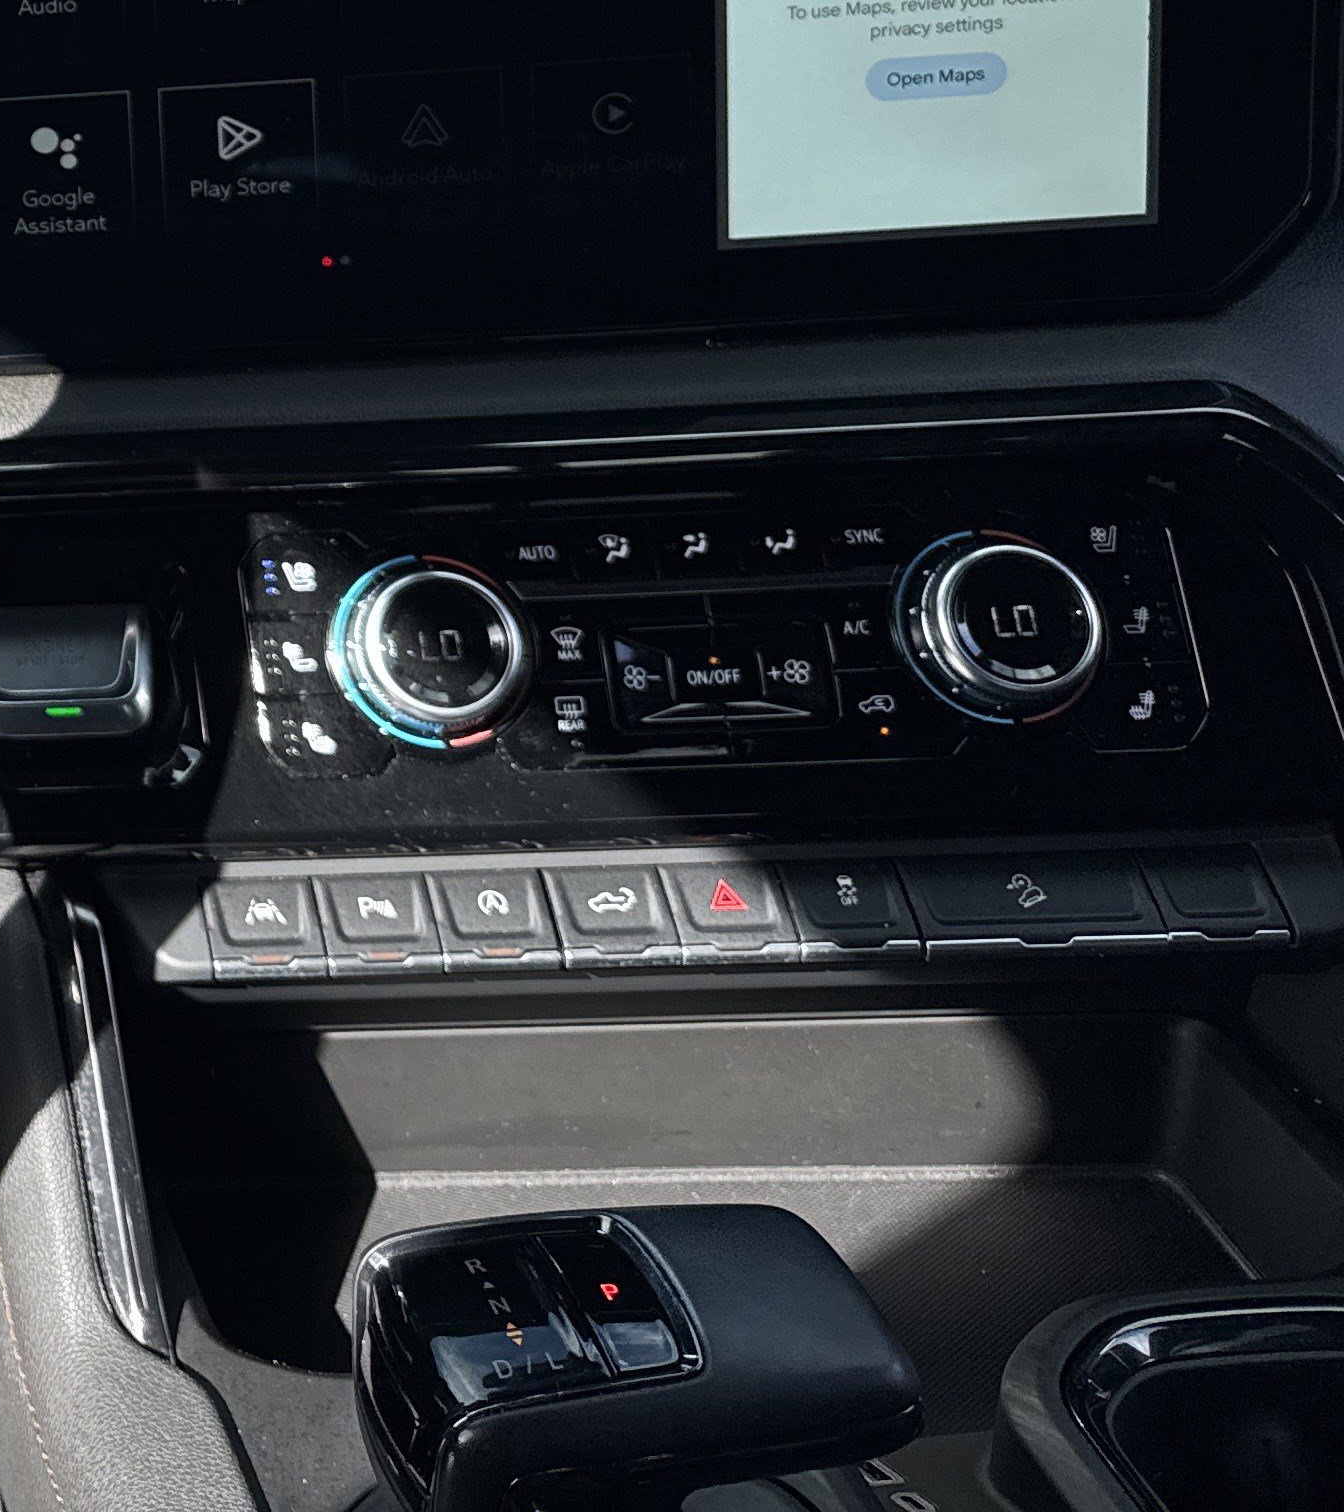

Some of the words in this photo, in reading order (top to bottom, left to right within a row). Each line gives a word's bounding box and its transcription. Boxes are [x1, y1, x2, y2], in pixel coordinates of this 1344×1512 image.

[787, 5, 808, 21] To
[810, 2, 842, 19] use
[869, 20, 931, 41] privacy
[935, 15, 1004, 37] settings
[886, 69, 935, 90] Open
[938, 65, 986, 86] Maps
[189, 178, 228, 201] Play
[231, 176, 292, 197] Store
[22, 187, 95, 211] Google
[13, 213, 107, 236] Assistant
[844, 527, 885, 545] SYNC
[518, 543, 557, 562] AUTO
[843, 619, 870, 637] A/C
[557, 648, 583, 662] MAX
[686, 667, 742, 686] ON/OFF
[557, 718, 586, 732] REAR
[464, 1258, 487, 1274] R
[600, 1283, 618, 1300] P
[490, 1297, 511, 1315] N
[492, 1359, 513, 1379] D
[545, 1351, 565, 1371] L
